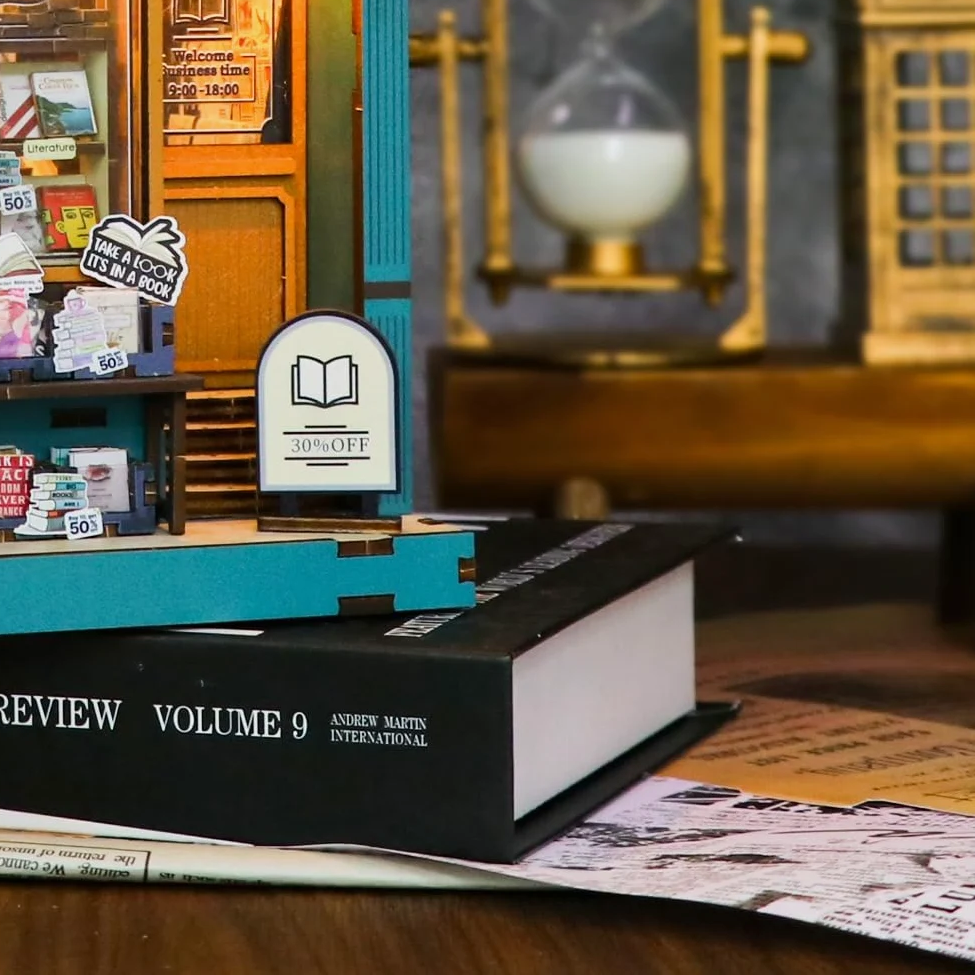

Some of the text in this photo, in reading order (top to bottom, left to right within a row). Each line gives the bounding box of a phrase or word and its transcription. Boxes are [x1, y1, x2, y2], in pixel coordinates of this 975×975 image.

[173, 50, 234, 62] Welcome
[220, 64, 251, 76] time
[27, 143, 75, 154] Literature
[95, 237, 178, 283] TAKE A LOOK
[110, 263, 126, 279] IN
[126, 270, 136, 284] A
[138, 274, 172, 299] BOOK
[18, 455, 34, 467] IS
[153, 703, 281, 740] VOLUME
[292, 711, 309, 740] 9
[330, 713, 427, 730] ANDREW MARTIN
[330, 728, 428, 747] INTERNATIONAL
[37, 847, 56, 859] of
[113, 854, 137, 866] the
[42, 862, 66, 877] We
